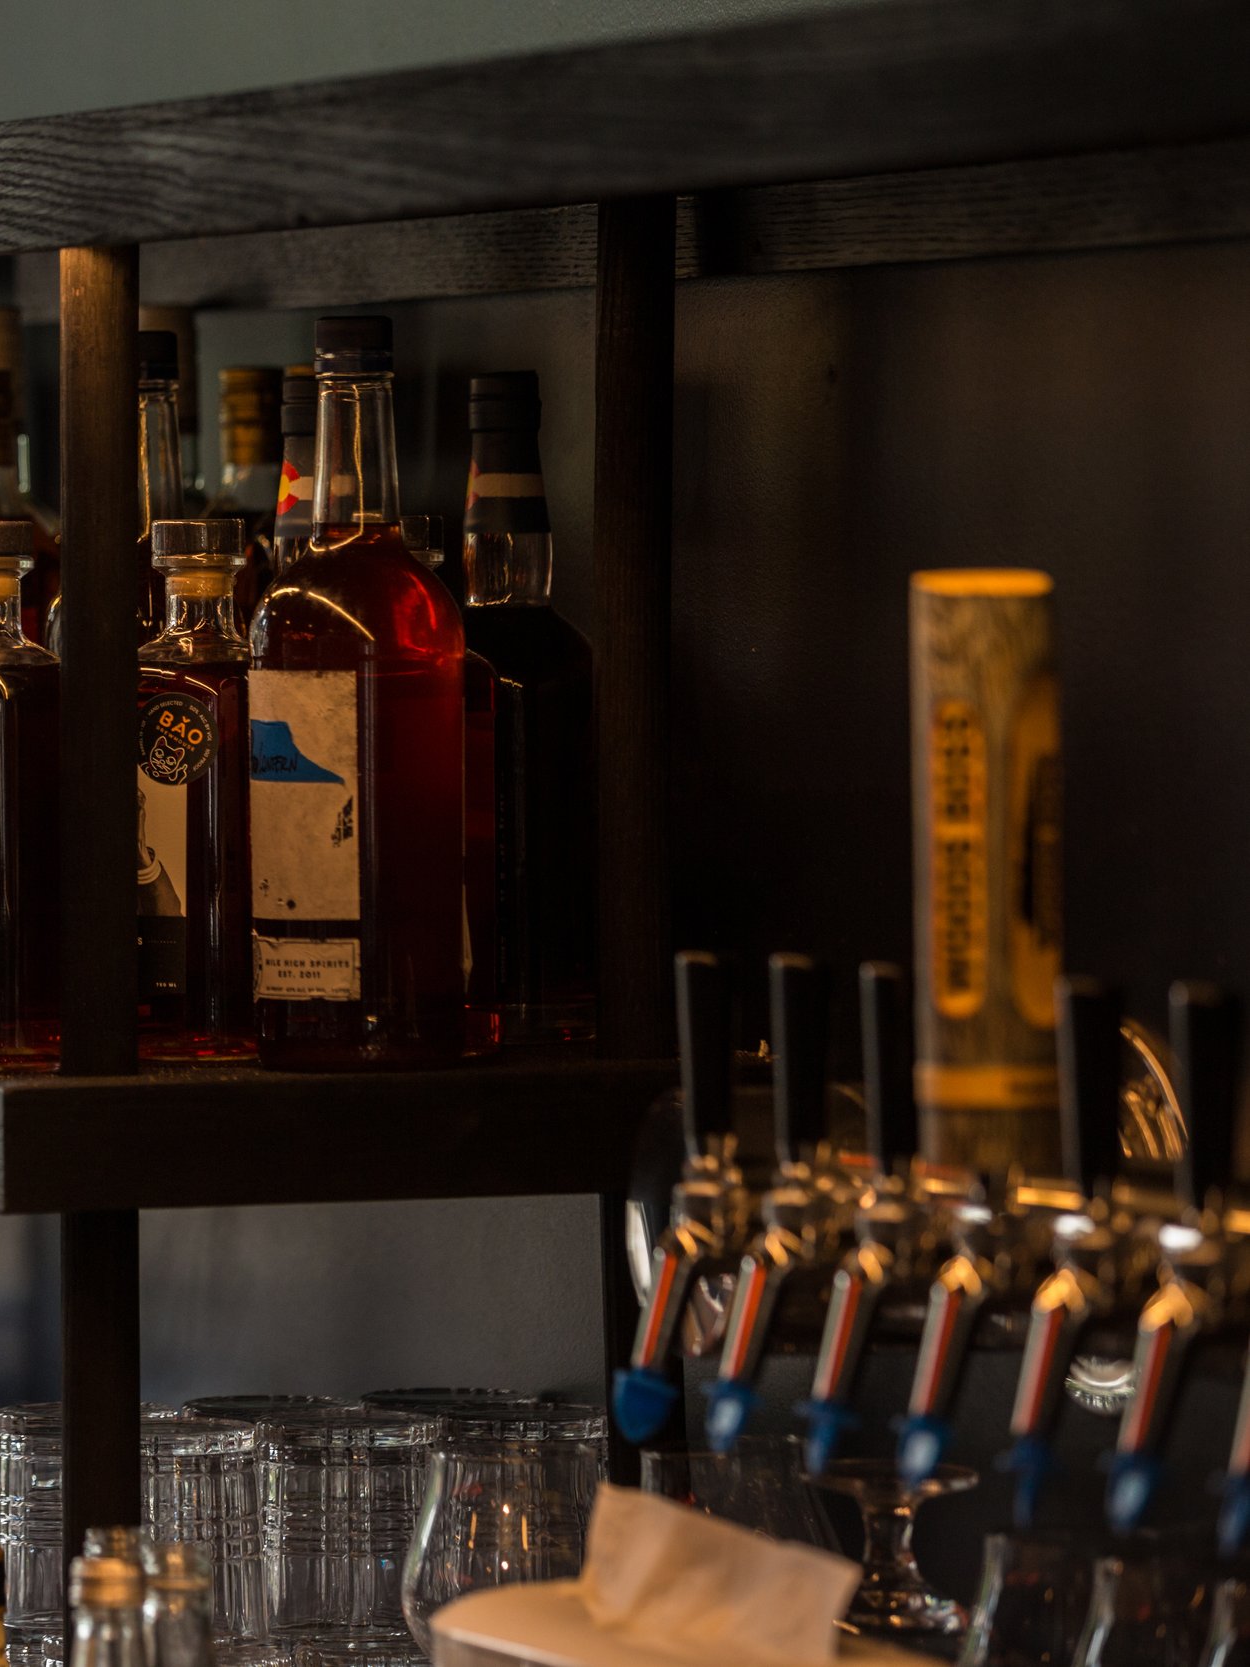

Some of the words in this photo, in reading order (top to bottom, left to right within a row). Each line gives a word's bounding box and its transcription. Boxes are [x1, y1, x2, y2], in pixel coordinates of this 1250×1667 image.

[265, 960, 281, 968] MILE
[284, 960, 306, 969] HIGH
[310, 960, 350, 969] SPIRITS
[278, 970, 296, 979] EST.
